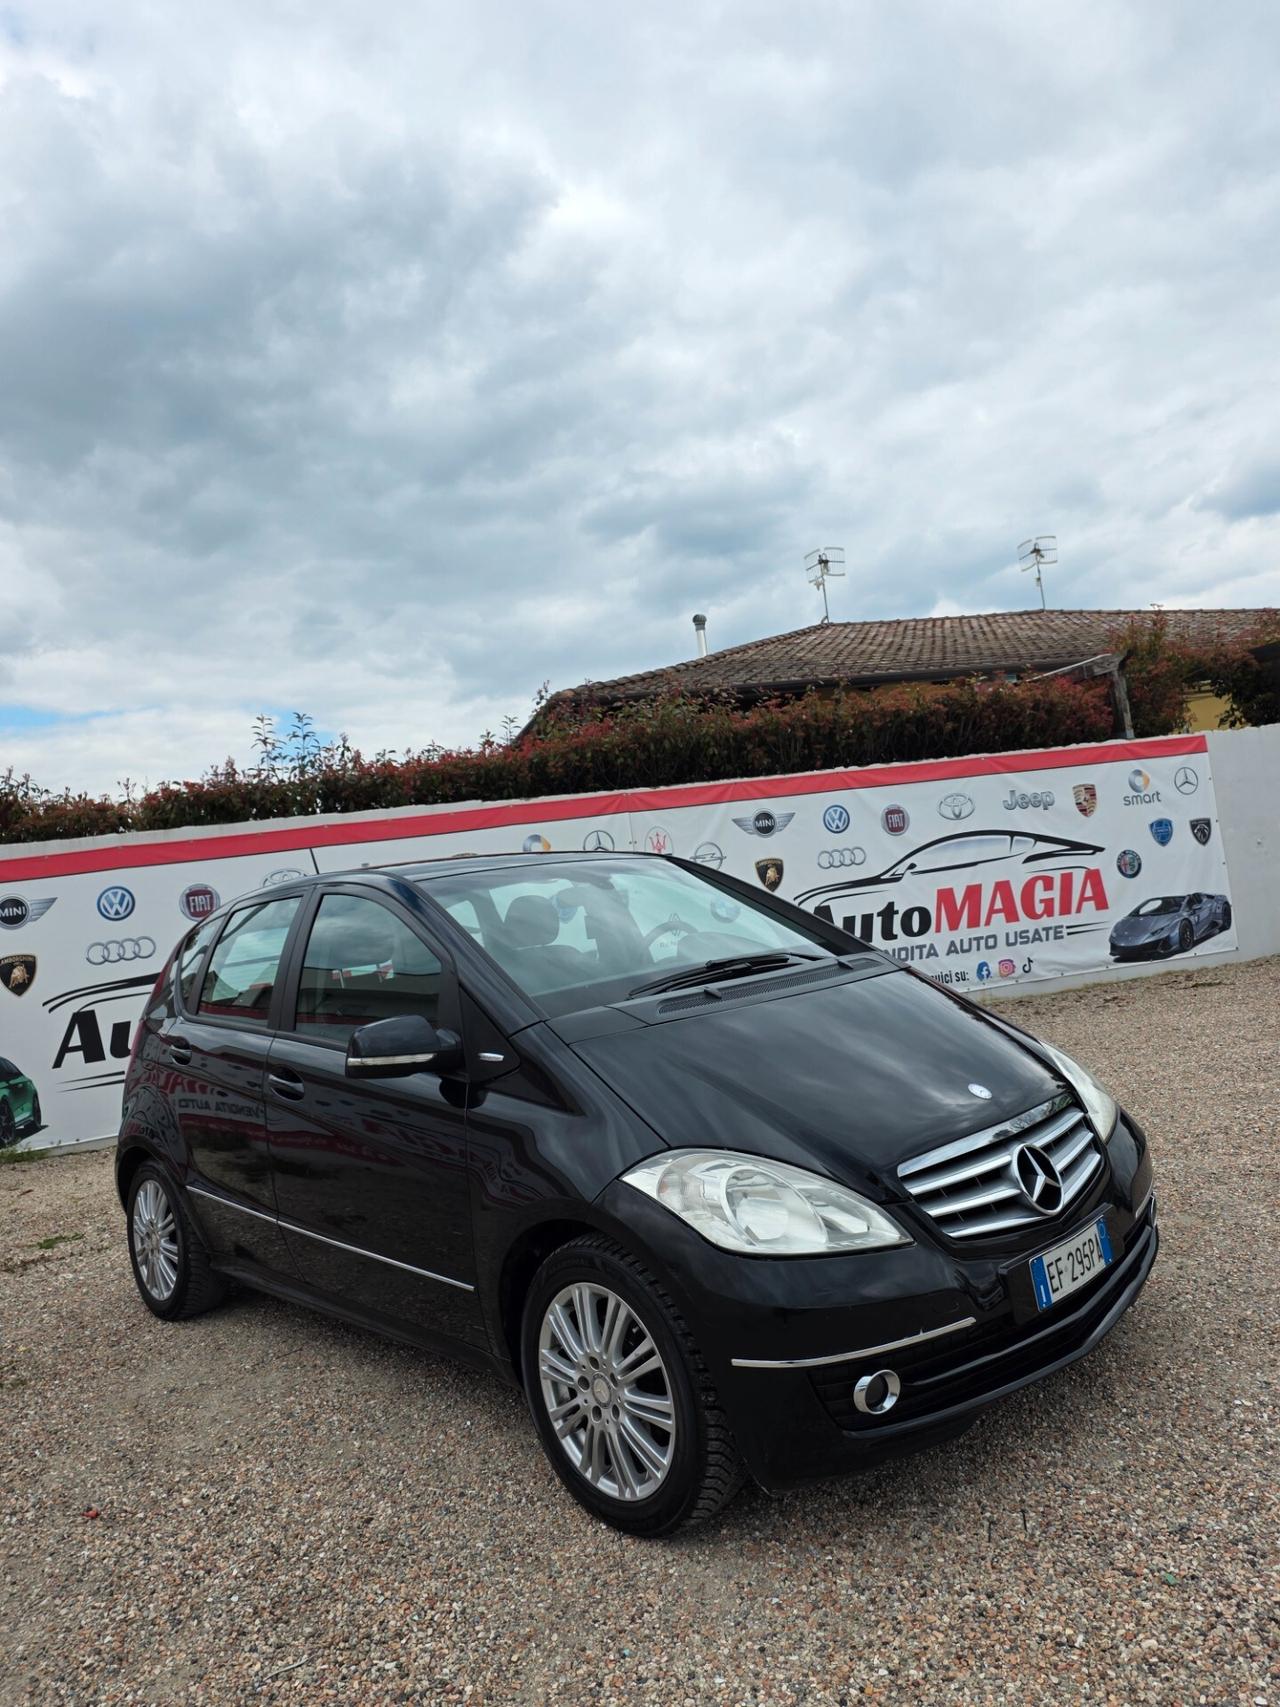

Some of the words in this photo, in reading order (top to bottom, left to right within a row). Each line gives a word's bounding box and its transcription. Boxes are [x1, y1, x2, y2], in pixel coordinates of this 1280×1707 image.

[1002, 789, 1055, 810] Jeep
[1123, 791, 1161, 806] smart
[755, 818, 775, 828] MINI
[887, 813, 904, 828] FIAT
[0, 905, 26, 917] MINI
[189, 894, 212, 913] FIAT
[946, 934, 998, 955] AUTO
[1006, 925, 1065, 947] USATE
[955, 971, 970, 982] su:
[1046, 1257, 1064, 1293] EF
